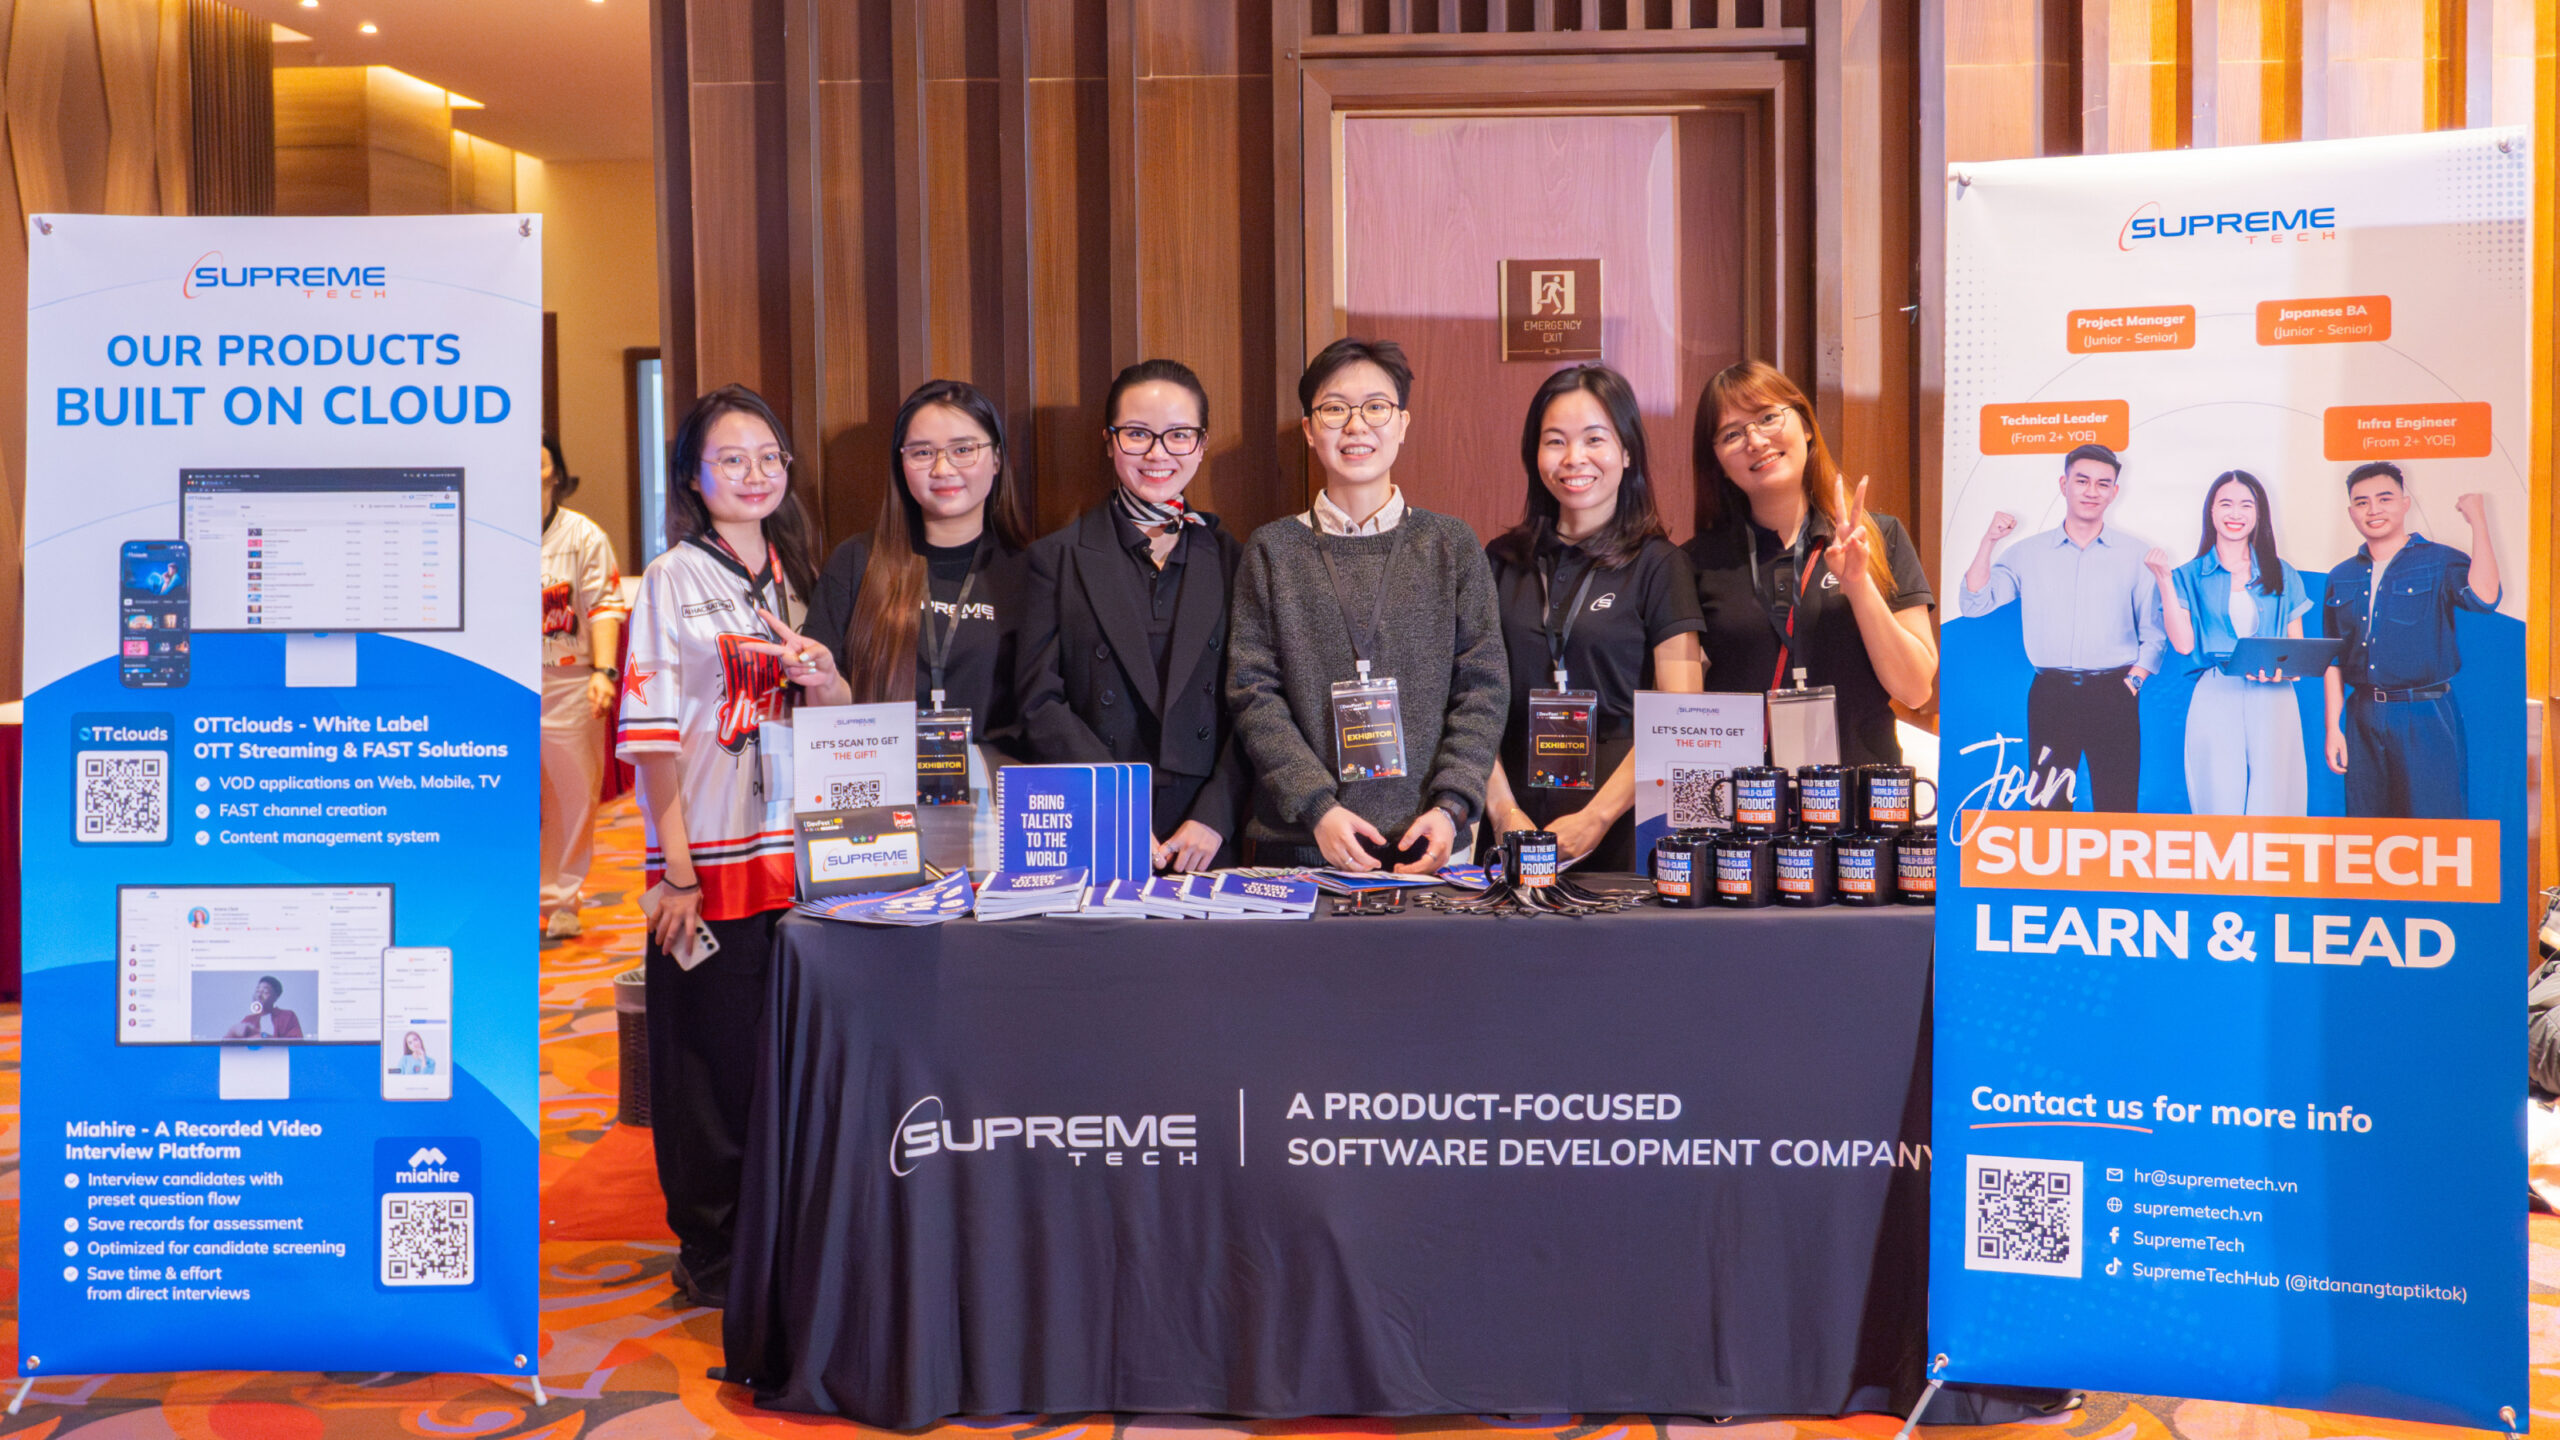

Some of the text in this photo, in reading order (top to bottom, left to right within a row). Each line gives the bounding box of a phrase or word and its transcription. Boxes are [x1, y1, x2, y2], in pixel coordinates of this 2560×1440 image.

[2132, 208, 2334, 239] SUPREME
[2245, 231, 2335, 244] TECH
[196, 267, 385, 287] SUPREME
[303, 289, 386, 299] TECH
[2077, 312, 2185, 330] Project Manager
[2280, 305, 2367, 322] Japanese BA
[1523, 320, 1582, 331] EMERGENCY
[2274, 327, 2314, 340] (Junior
[2328, 323, 2372, 335] Senior)
[1543, 332, 1562, 342] EXIT
[2084, 335, 2123, 348] (Junior
[2135, 332, 2178, 344] Senior)
[108, 334, 460, 366] OUR PRODUCTS
[57, 386, 510, 426] BUILT ON CLOUD
[2000, 412, 2108, 425] Technical Leader
[2358, 416, 2457, 430] Infra Engineer
[2011, 430, 2096, 445] (From 2+ YOE)
[2363, 435, 2455, 450] (From 2+ YOE)
[194, 716, 293, 733] OTTclouds
[313, 716, 371, 732] White
[377, 715, 428, 732] Label
[1652, 726, 1744, 736] LET'S SCAN TO GET
[811, 736, 899, 749] LET'S SCAN TO GET
[1347, 731, 1392, 741] EXHIBITOR
[1676, 739, 1721, 748] THE GIFT!
[194, 741, 508, 762] OTT Streaming & FAST Solutions
[833, 750, 877, 760] THE GIFT!
[220, 775, 501, 792] VOD applications on Web, Mobile, TV
[1950, 732, 2077, 846] Join
[220, 803, 387, 817] FAST channel creation
[1029, 795, 1064, 810] BRING
[1737, 797, 1775, 809] PRODUCT
[1802, 797, 1839, 809] PRODUCT
[1872, 796, 1909, 808] PRODUCT
[1021, 813, 1072, 829] TALENTS
[220, 830, 440, 847] Content management system
[1026, 832, 1066, 847] TO THE
[828, 850, 908, 866] SUPREME
[1026, 851, 1067, 866] WORLD
[1976, 826, 2472, 887] SUPREMETECH
[1976, 904, 2455, 968] LEARN & LEAD
[1287, 1093, 1681, 1120] A PRODUCT-FOCUSED
[1972, 1086, 2372, 1133] Contact us for more info
[66, 1121, 136, 1137] Miahire
[154, 1121, 170, 1137] A
[175, 1120, 263, 1137] Recorded
[268, 1120, 322, 1136] Video
[903, 1115, 1196, 1157] SUPREME
[66, 1142, 241, 1159] Interview Platform
[1068, 1151, 1197, 1166] TECH
[1288, 1138, 1487, 1165] SOFTWARE
[1500, 1139, 1760, 1165] DEVELOPMENT
[88, 1171, 283, 1186] Interview candidates with
[396, 1168, 459, 1184] miahire
[2134, 1168, 2297, 1192] hr@supremetech.vn
[88, 1191, 241, 1209] preset question flow
[2134, 1200, 2263, 1222] supremetech.vn
[88, 1216, 303, 1231] Save records for assessment
[88, 1240, 345, 1257] Optimized for candidate screening
[2134, 1231, 2244, 1252] SupremeTech
[88, 1266, 222, 1280] Save time & effort
[2133, 1262, 2467, 1304] SupremeTechHub (@itdanangtaptiktok)
[87, 1286, 250, 1300] from direct interviews
